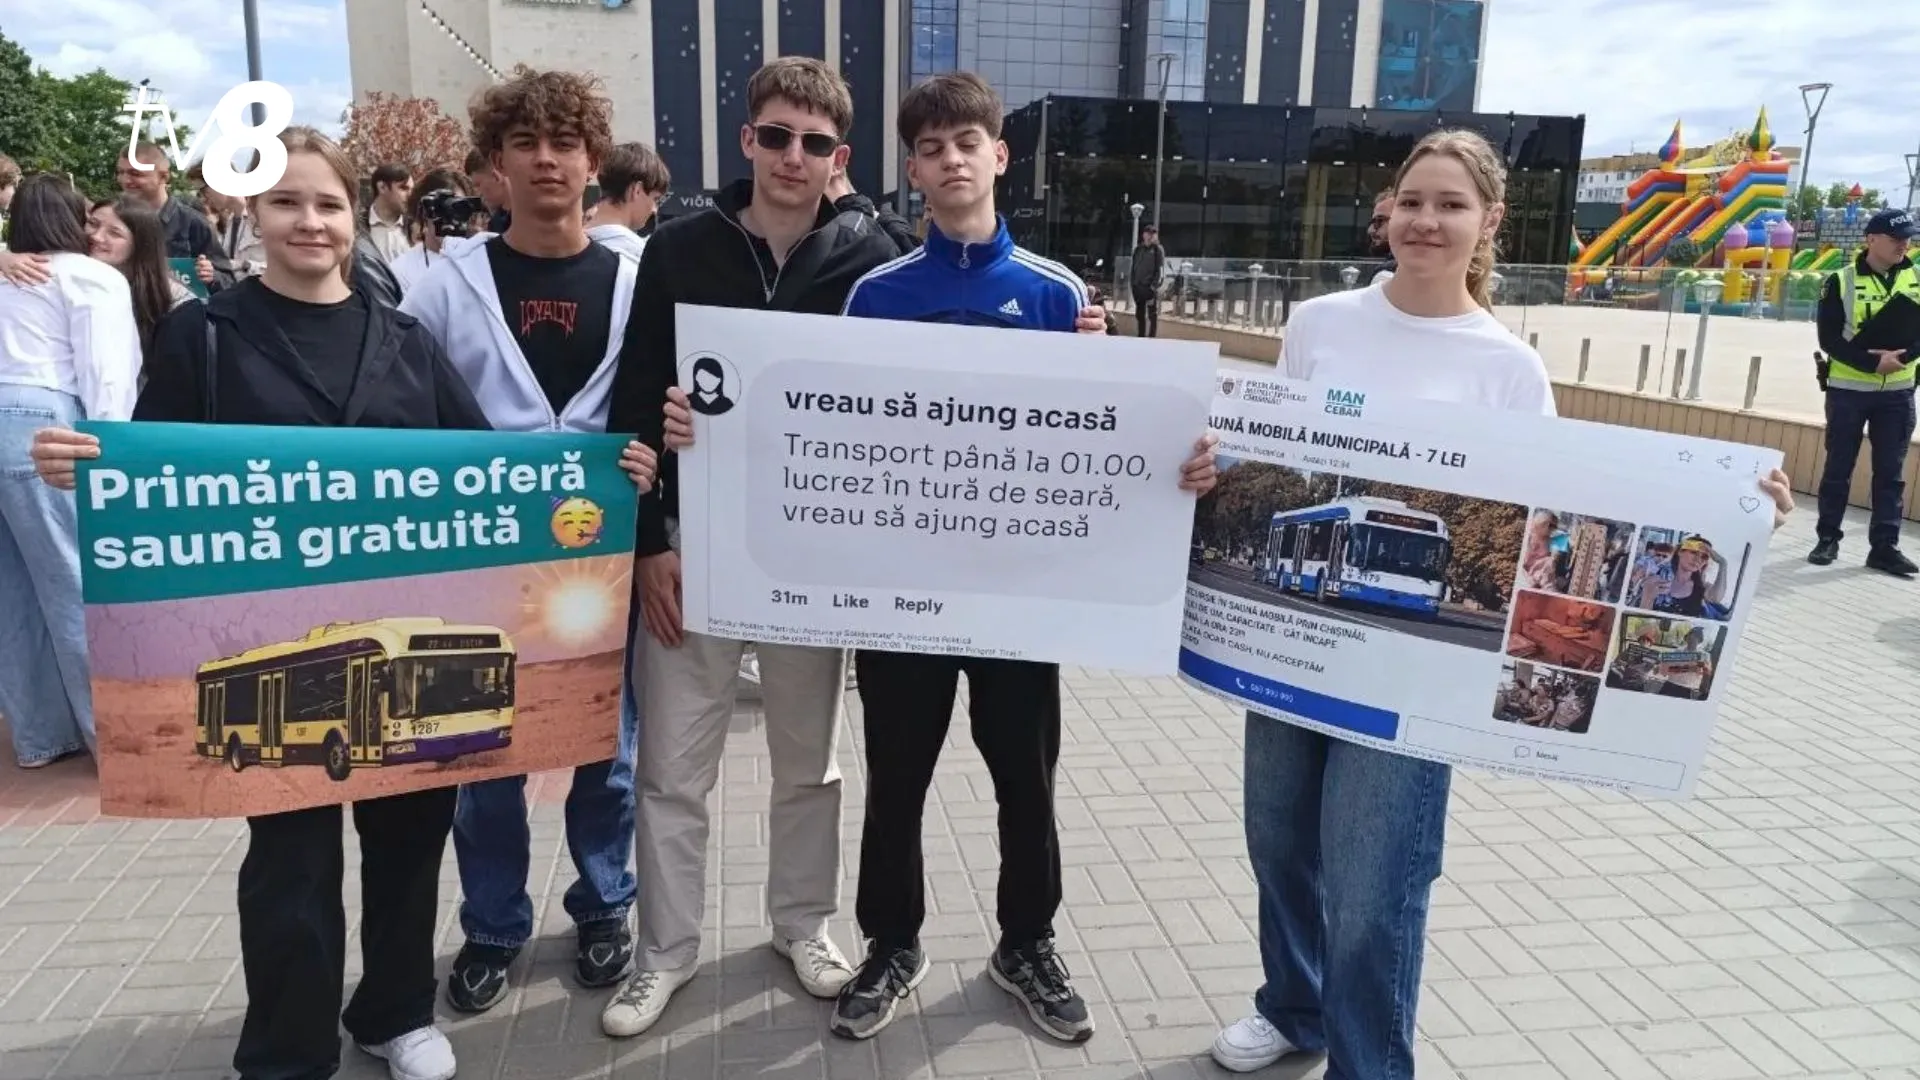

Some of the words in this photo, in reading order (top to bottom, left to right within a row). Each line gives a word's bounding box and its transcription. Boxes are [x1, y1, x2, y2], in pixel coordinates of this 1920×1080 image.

[520, 299, 578, 339] LOYALTY
[785, 390, 875, 416] vreau
[883, 392, 918, 418] să
[926, 398, 1017, 431] ajung
[1025, 405, 1118, 432] acasă
[1324, 404, 1362, 418] CEBAN
[1326, 388, 1366, 405] MAN
[784, 433, 935, 466] Transport
[943, 445, 1016, 472] până
[1025, 449, 1050, 474] la
[1060, 451, 1153, 481] 01.00,
[1248, 420, 1308, 443] MOBILĂ
[1311, 431, 1410, 460] MUNICIPALĂ
[1427, 448, 1438, 463] 7
[1440, 451, 1466, 468] LEI
[88, 458, 357, 510] Primăria
[373, 467, 440, 499] ne
[454, 450, 586, 496] oferă
[783, 467, 874, 495] lucrez
[882, 471, 910, 497] în
[920, 475, 979, 501] tură
[989, 481, 1026, 505] de
[1034, 482, 1122, 511] seară,
[93, 517, 282, 570] saună
[298, 505, 520, 568] gratuită
[783, 503, 865, 527] vreau
[874, 504, 905, 528] să
[914, 508, 997, 539] ajung
[1006, 514, 1089, 539] acasă
[771, 589, 808, 605] 31m
[832, 594, 870, 608] Like
[894, 596, 943, 615] Reply
